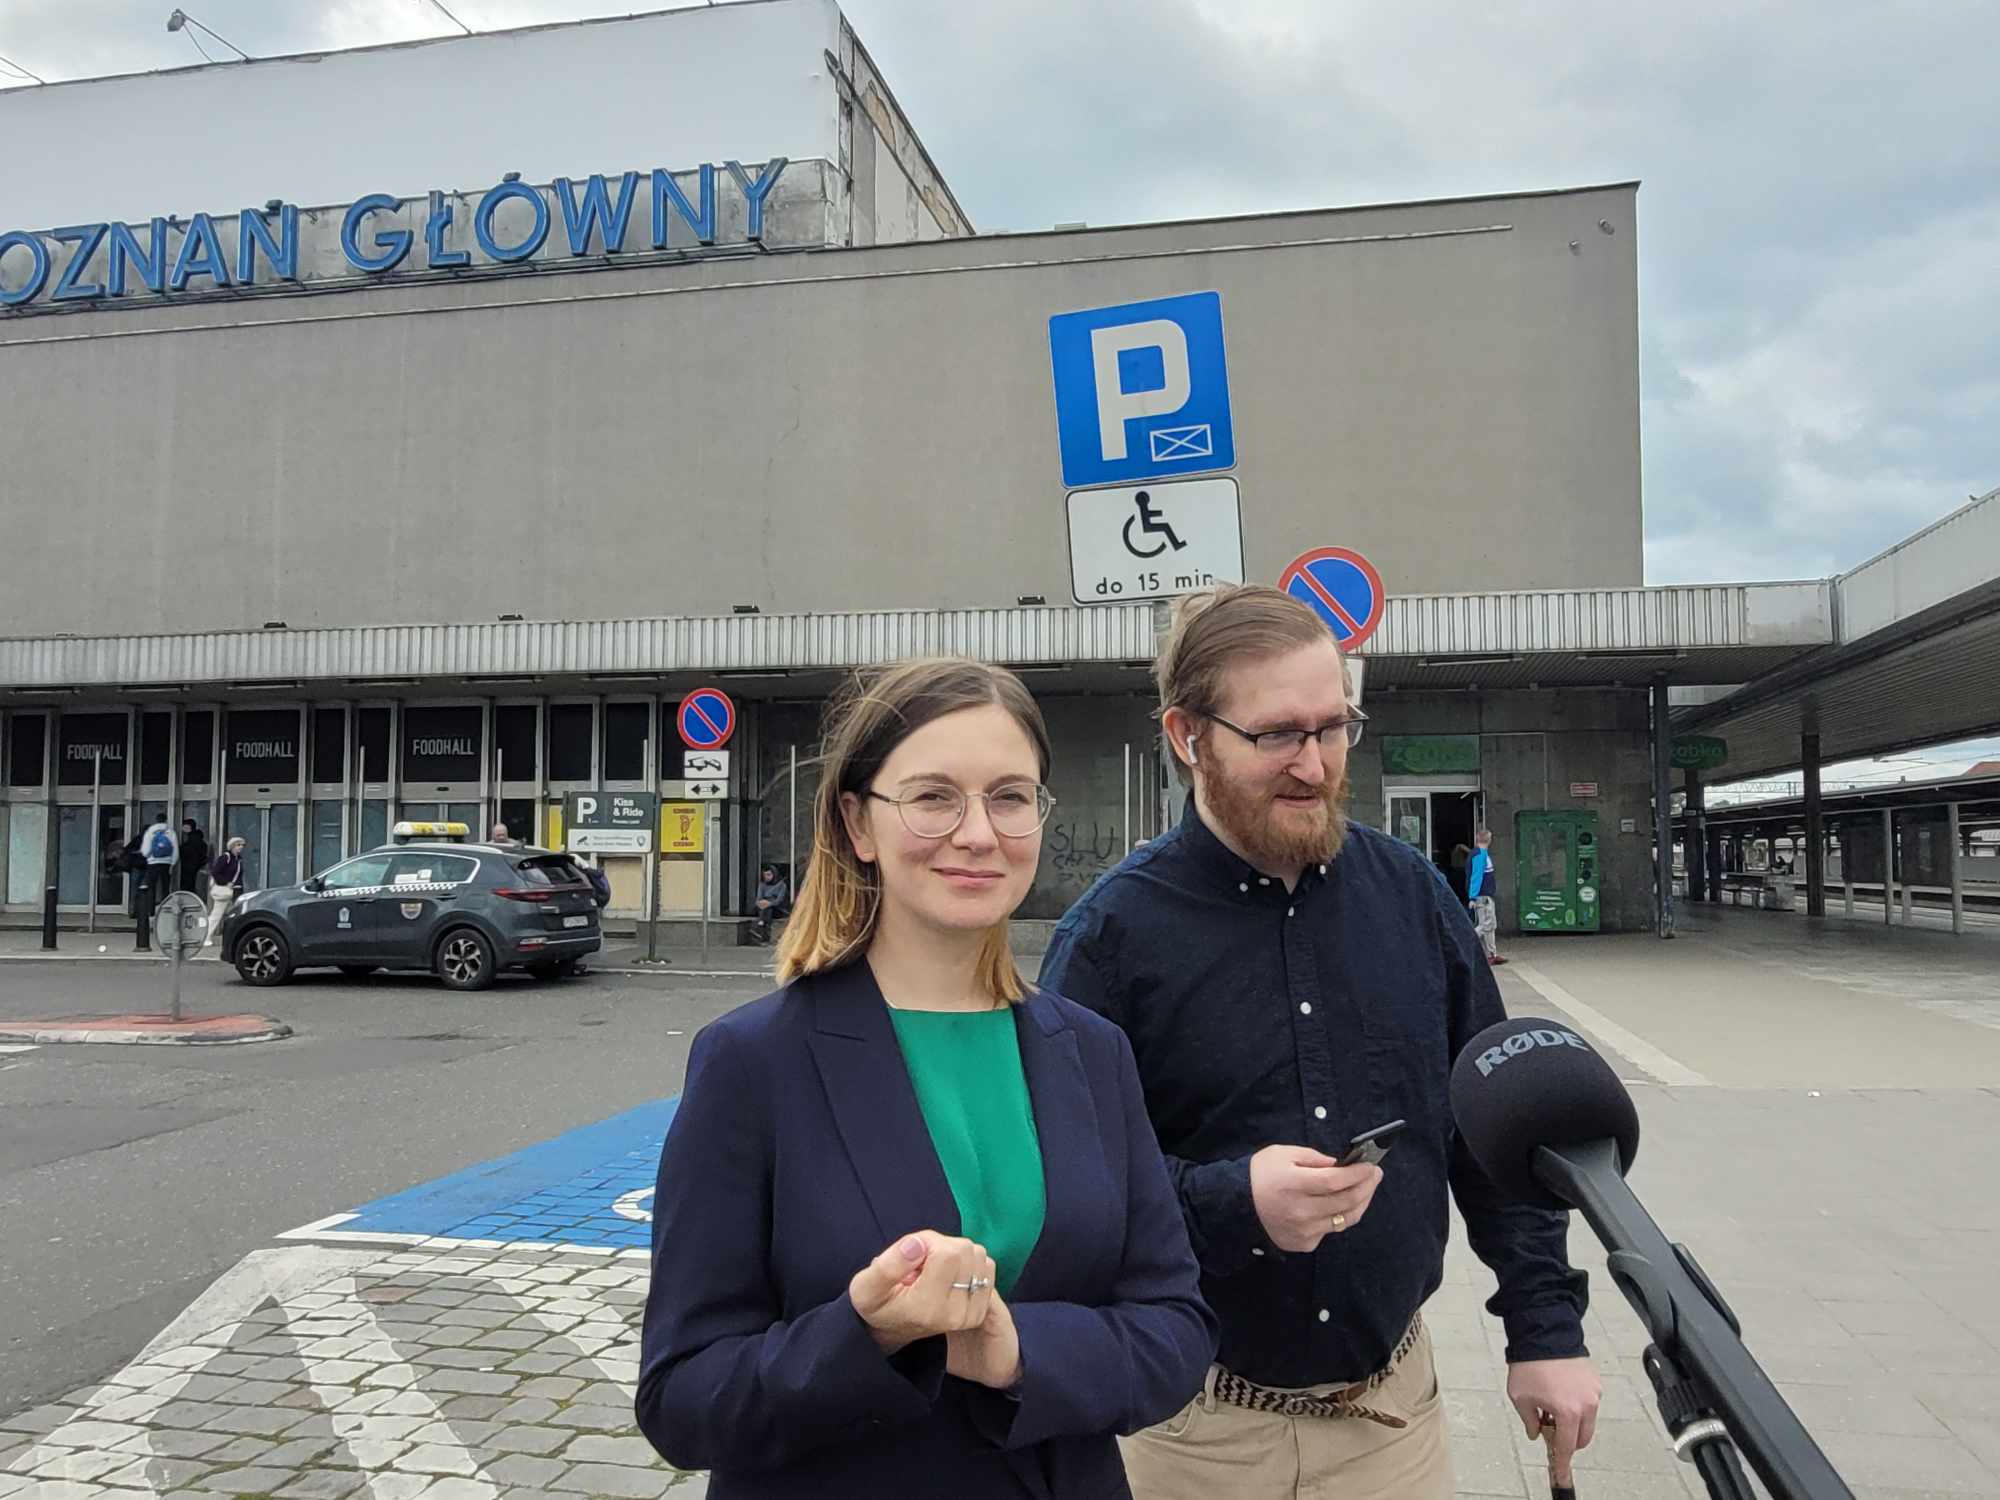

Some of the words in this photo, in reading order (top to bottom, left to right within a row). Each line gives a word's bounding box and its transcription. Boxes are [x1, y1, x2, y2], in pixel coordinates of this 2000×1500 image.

[340, 156, 788, 274] GŁÓWNY
[1090, 319, 1192, 461] P
[1096, 577, 1122, 595] do
[1138, 573, 1160, 591] 15
[1175, 568, 1214, 589] min
[67, 743, 123, 760] FOODHALL
[235, 741, 295, 758] FOODHALL
[412, 738, 474, 756] FOODHALL
[577, 797, 598, 823] P
[612, 807, 621, 817] &
[622, 807, 644, 817] Ride
[1475, 1029, 1591, 1078] RØDE
